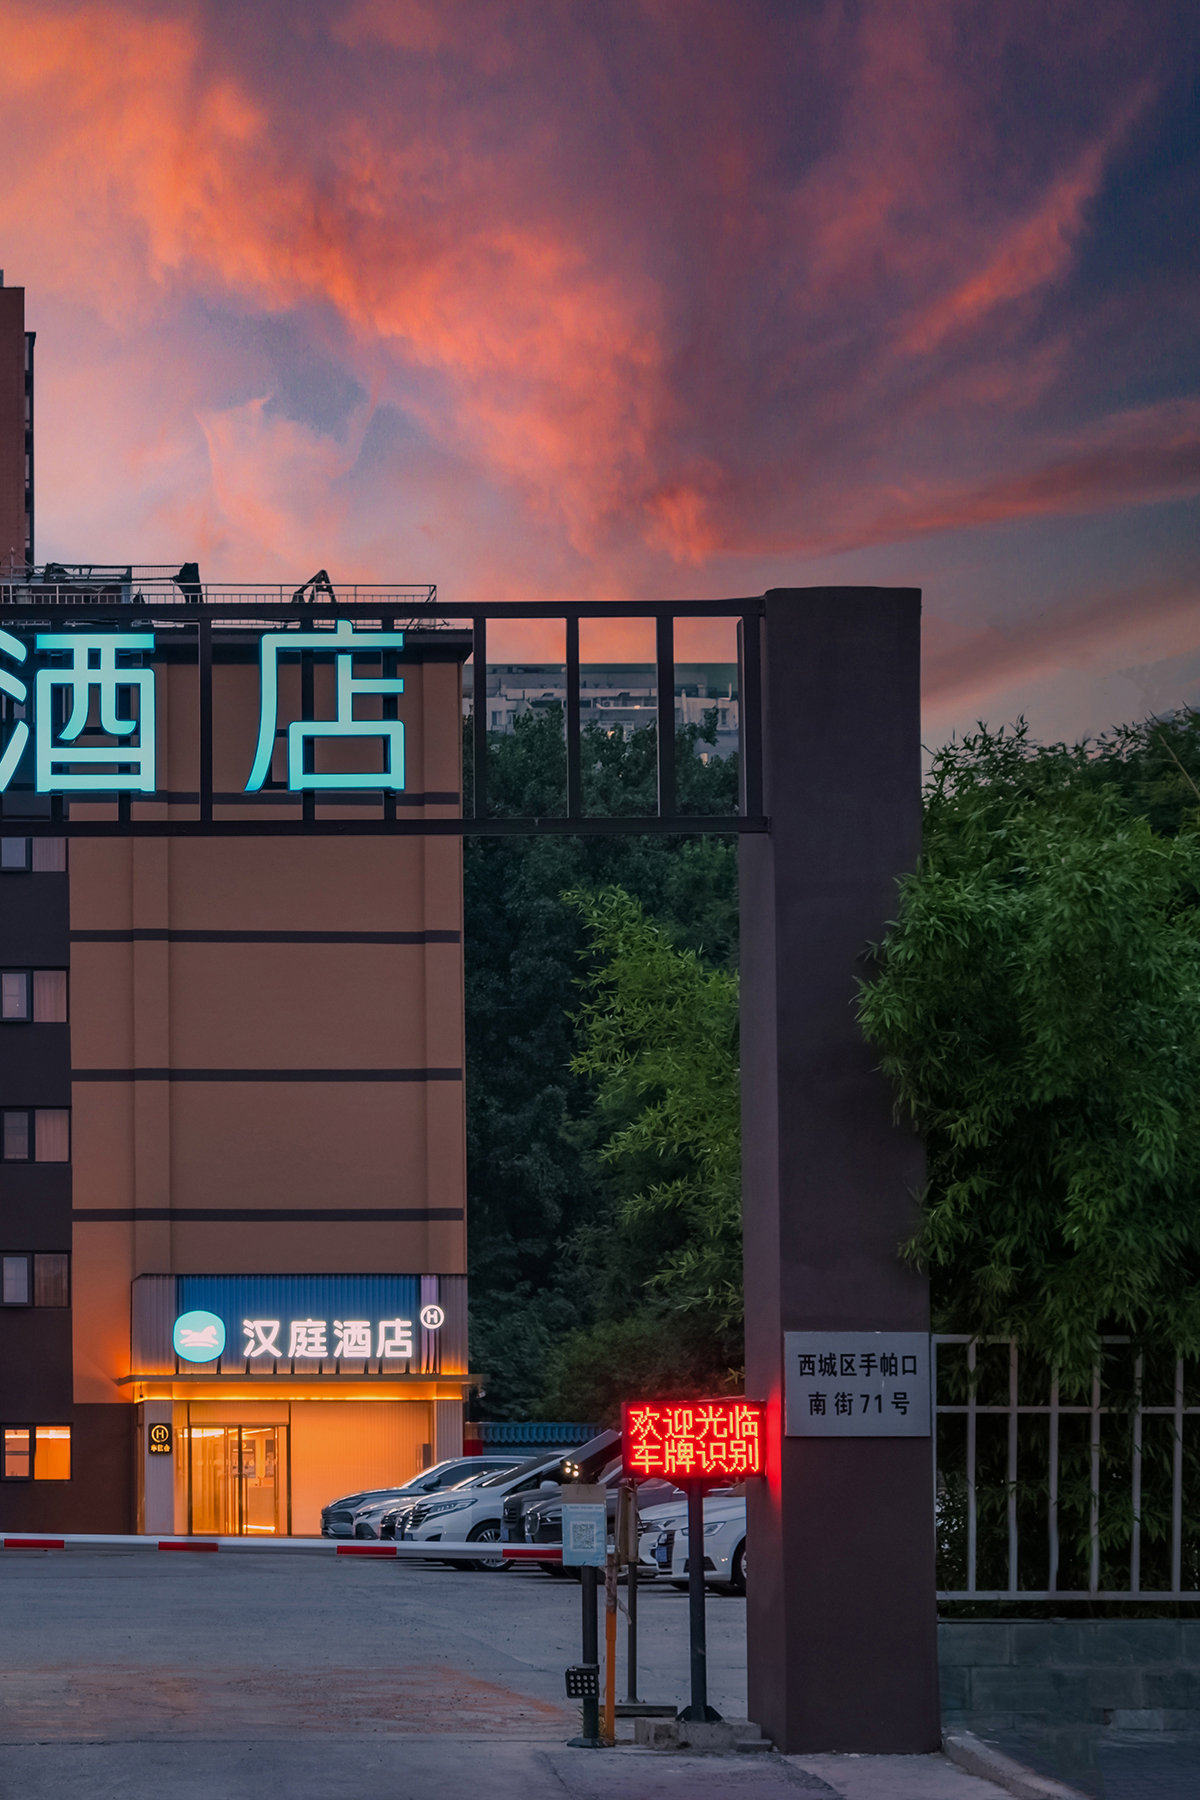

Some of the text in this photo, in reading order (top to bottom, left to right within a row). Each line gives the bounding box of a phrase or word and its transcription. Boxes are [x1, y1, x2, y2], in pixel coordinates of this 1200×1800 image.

[243, 1318, 413, 1358] 汉庭酒店
[798, 1352, 918, 1378] 西城区手帕口
[809, 1392, 911, 1416] 南街71号
[629, 1406, 760, 1441] 欢迎光临
[629, 1439, 760, 1473] 车牌识别
